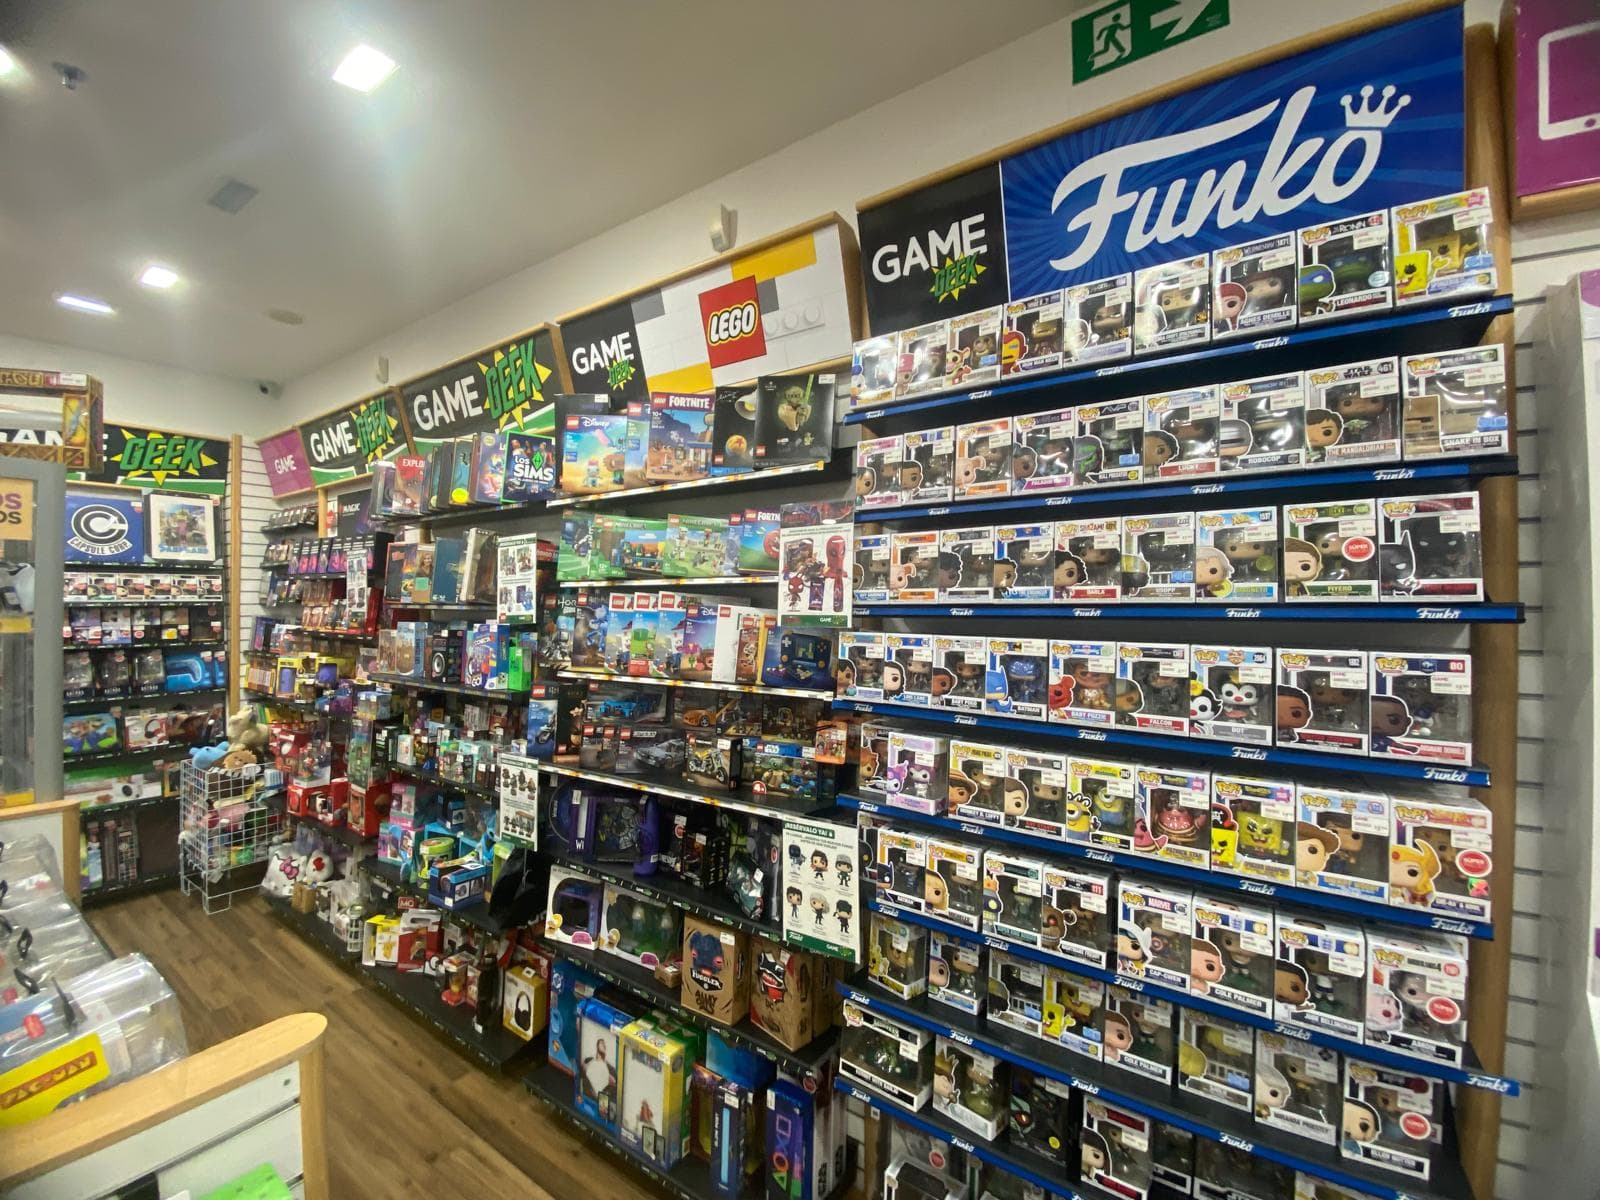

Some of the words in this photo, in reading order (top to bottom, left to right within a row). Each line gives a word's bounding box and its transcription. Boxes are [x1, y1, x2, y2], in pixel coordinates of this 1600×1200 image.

[1049, 84, 1384, 271] Funko
[1398, 205, 1428, 220] POP!
[1302, 228, 1329, 240] POP!
[872, 213, 988, 283] GAME
[934, 252, 978, 297] GEEK
[1336, 295, 1373, 306] LEONARDO
[1448, 302, 1492, 318] Funko
[710, 303, 756, 343] LEGO
[1252, 336, 1290, 350] Funko
[572, 332, 635, 374] GAME
[608, 359, 631, 385] GEEK
[1344, 366, 1373, 374] STAR
[1344, 371, 1372, 380] WARS
[414, 375, 483, 431] GAME
[485, 338, 542, 420] GEEK
[1310, 372, 1338, 385] POP!
[668, 396, 711, 408] FORTNITE
[1101, 404, 1127, 414] AVP
[581, 416, 610, 428] Disney
[310, 421, 356, 463] GAME
[356, 398, 394, 457] GEEK
[1443, 437, 1471, 447] SNAKE
[1483, 435, 1500, 443] BOX
[119, 437, 207, 471] GEEK
[1327, 447, 1340, 457] THE
[1341, 443, 1384, 456] MANDALORIAN
[274, 456, 296, 474] GAME
[1247, 455, 1281, 465] ROBOCOP
[513, 464, 554, 482] SIMS
[1373, 469, 1415, 480] Funko
[1191, 484, 1225, 494] Funko
[343, 503, 360, 513] MAGIC
[1289, 507, 1318, 518] POP!
[1382, 502, 1415, 513] POP!
[70, 538, 106, 555] CAPSULE
[1225, 608, 1262, 618] Funko
[1416, 608, 1462, 619] Funko
[1121, 647, 1142, 657] POP!
[1194, 650, 1219, 660] POP!
[1280, 654, 1309, 665] POP!
[1375, 657, 1406, 668] POP!
[1450, 661, 1463, 670] 80
[1017, 706, 1040, 714] BATMAN
[1150, 718, 1173, 726] FALCON
[1078, 729, 1106, 741] Funko
[1232, 747, 1267, 760] Funko
[1138, 771, 1161, 783] POP!
[1424, 767, 1468, 782] Funko
[1216, 781, 1241, 793] POP!
[1301, 794, 1330, 806] POP!
[1395, 806, 1425, 820] POP!
[1085, 849, 1114, 863] Funko
[1240, 880, 1276, 895] Funko
[1122, 890, 1145, 904] POP!
[1148, 897, 1172, 911] MARVEL
[1196, 909, 1221, 922] POP!
[1431, 917, 1475, 934] Funko
[1280, 928, 1308, 943] POP!
[1374, 948, 1404, 963] POP!
[691, 971, 722, 989] FUGGLER
[1113, 975, 1145, 992] Funko
[1214, 987, 1232, 1000] COLE
[1234, 993, 1263, 1007] PALMER
[950, 1030, 974, 1045] Funko
[1275, 1022, 1311, 1041] Funko
[1123, 1054, 1139, 1065] COLE
[1071, 1078, 1100, 1095] Funko
[1467, 1074, 1511, 1093] Funko
[851, 1088, 871, 1103] Funko
[1273, 1111, 1301, 1125] MIRANDA
[951, 1136, 975, 1153] Funko
[1219, 1132, 1254, 1152] Funko
